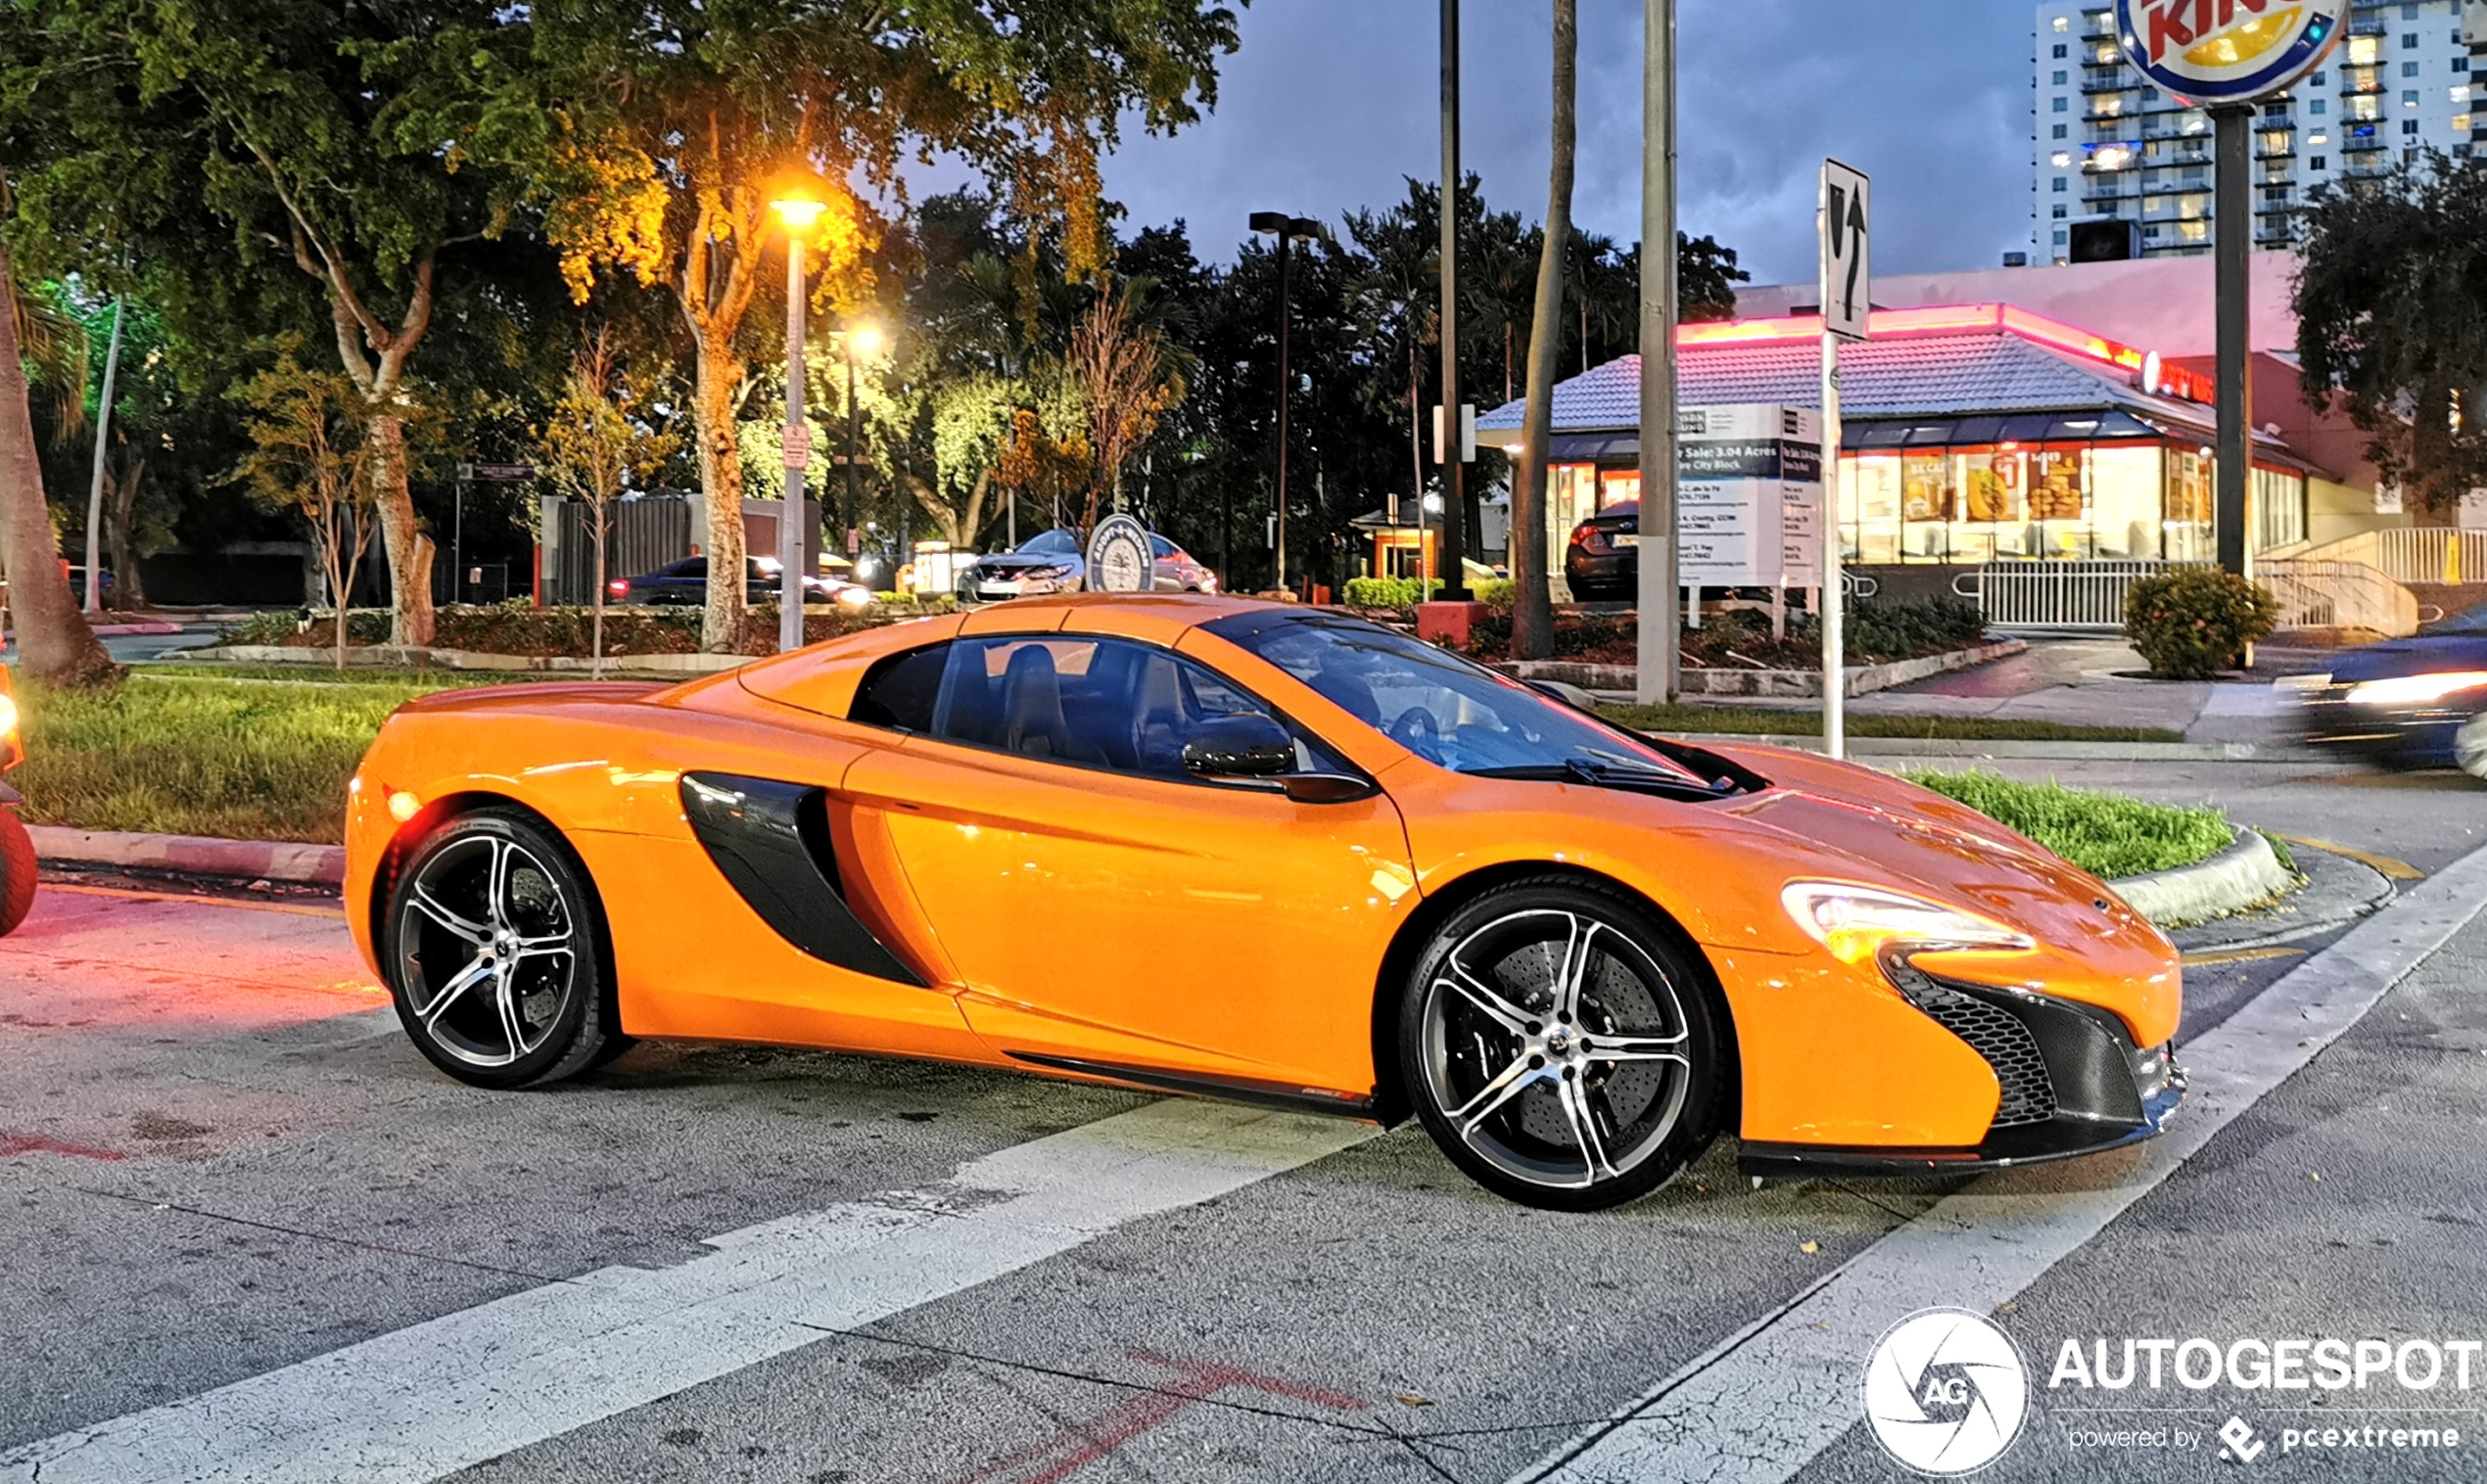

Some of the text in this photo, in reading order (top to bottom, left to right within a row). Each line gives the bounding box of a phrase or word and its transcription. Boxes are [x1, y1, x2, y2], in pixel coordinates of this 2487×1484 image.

[1685, 447, 1713, 458] Sale:
[1715, 447, 1741, 457] 3.04
[1745, 446, 1777, 456] Acres
